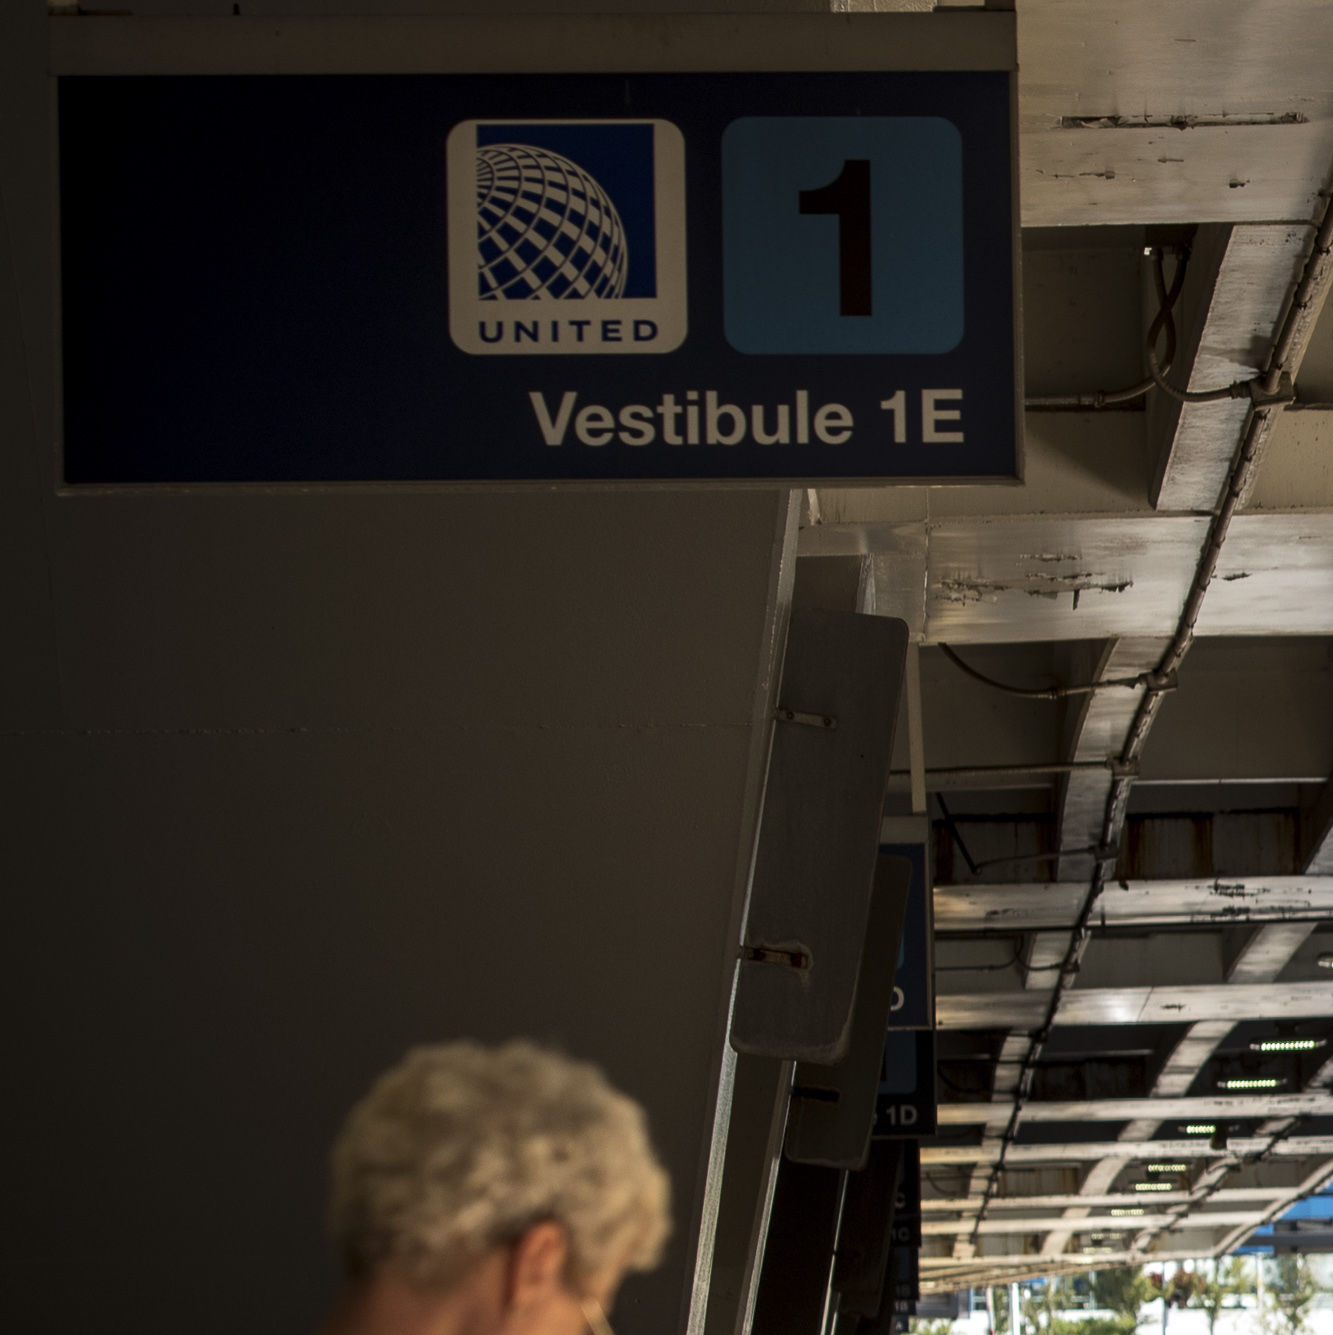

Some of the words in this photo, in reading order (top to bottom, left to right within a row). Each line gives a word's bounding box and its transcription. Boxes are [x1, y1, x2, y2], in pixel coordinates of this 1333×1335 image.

[799, 159, 873, 316] 1
[478, 319, 659, 344] UNITED
[529, 389, 853, 446] Vestibule
[880, 388, 965, 443] 1E
[886, 1104, 918, 1126] 1D
